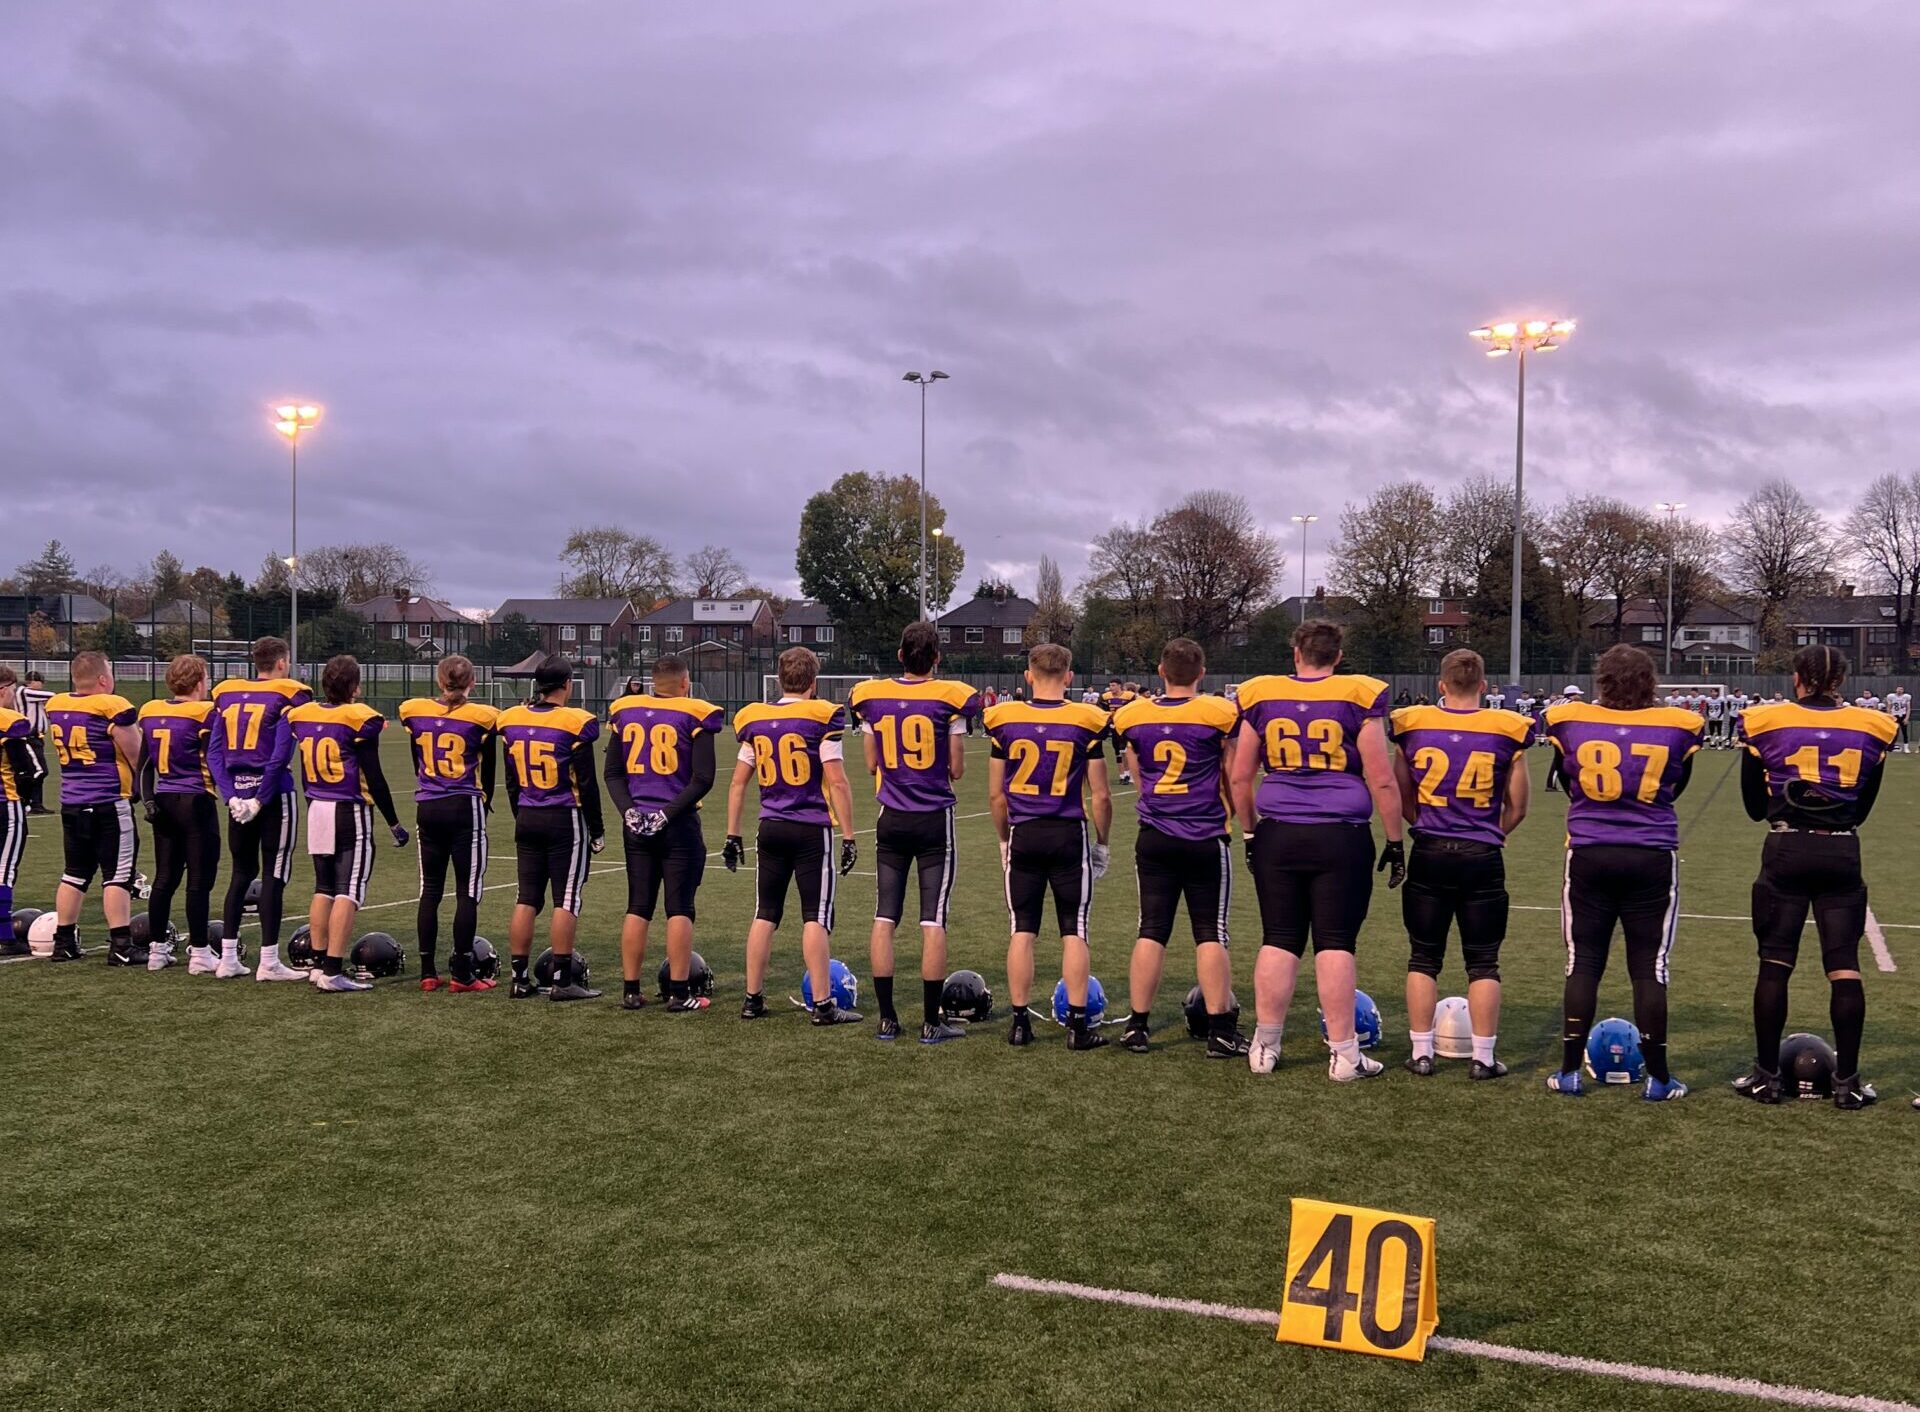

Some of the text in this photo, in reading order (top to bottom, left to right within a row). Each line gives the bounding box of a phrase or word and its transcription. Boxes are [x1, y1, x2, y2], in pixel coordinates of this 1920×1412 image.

[48, 724, 97, 766] 64
[153, 728, 170, 774] 7
[223, 703, 265, 750] 17
[622, 722, 679, 776] 28
[873, 714, 936, 770] 19
[1265, 717, 1348, 771] 63
[297, 736, 344, 784] 10
[415, 731, 466, 779] 13
[508, 740, 559, 790] 15
[753, 732, 811, 787] 86
[1008, 738, 1074, 797] 27
[1153, 740, 1189, 795] 2
[1414, 747, 1496, 808] 24
[1576, 740, 1669, 803] 87
[1785, 745, 1862, 788] 11
[1287, 1213, 1423, 1350] 40
